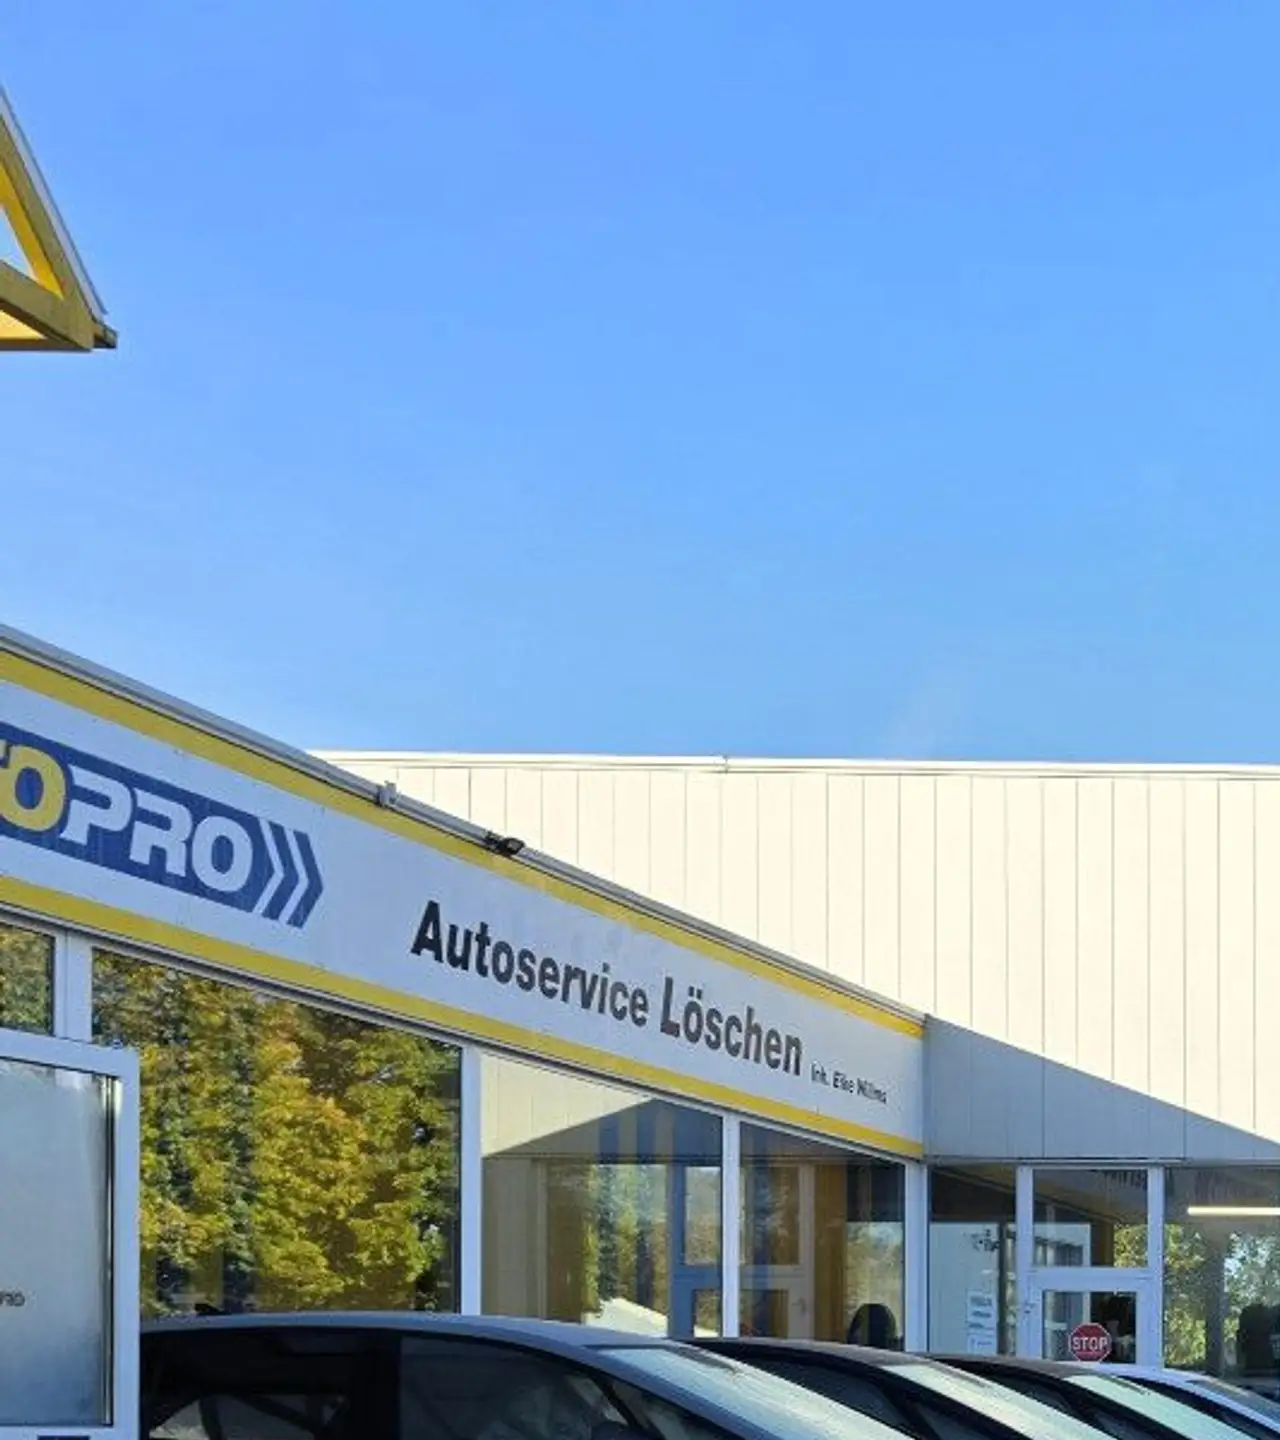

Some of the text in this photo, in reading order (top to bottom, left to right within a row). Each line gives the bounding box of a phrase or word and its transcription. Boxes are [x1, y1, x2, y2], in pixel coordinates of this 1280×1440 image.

[0, 739, 254, 893] OPRO
[411, 900, 650, 1027] Autoservice
[660, 976, 802, 1076] Löschen
[1072, 1336, 1109, 1351] STOP
